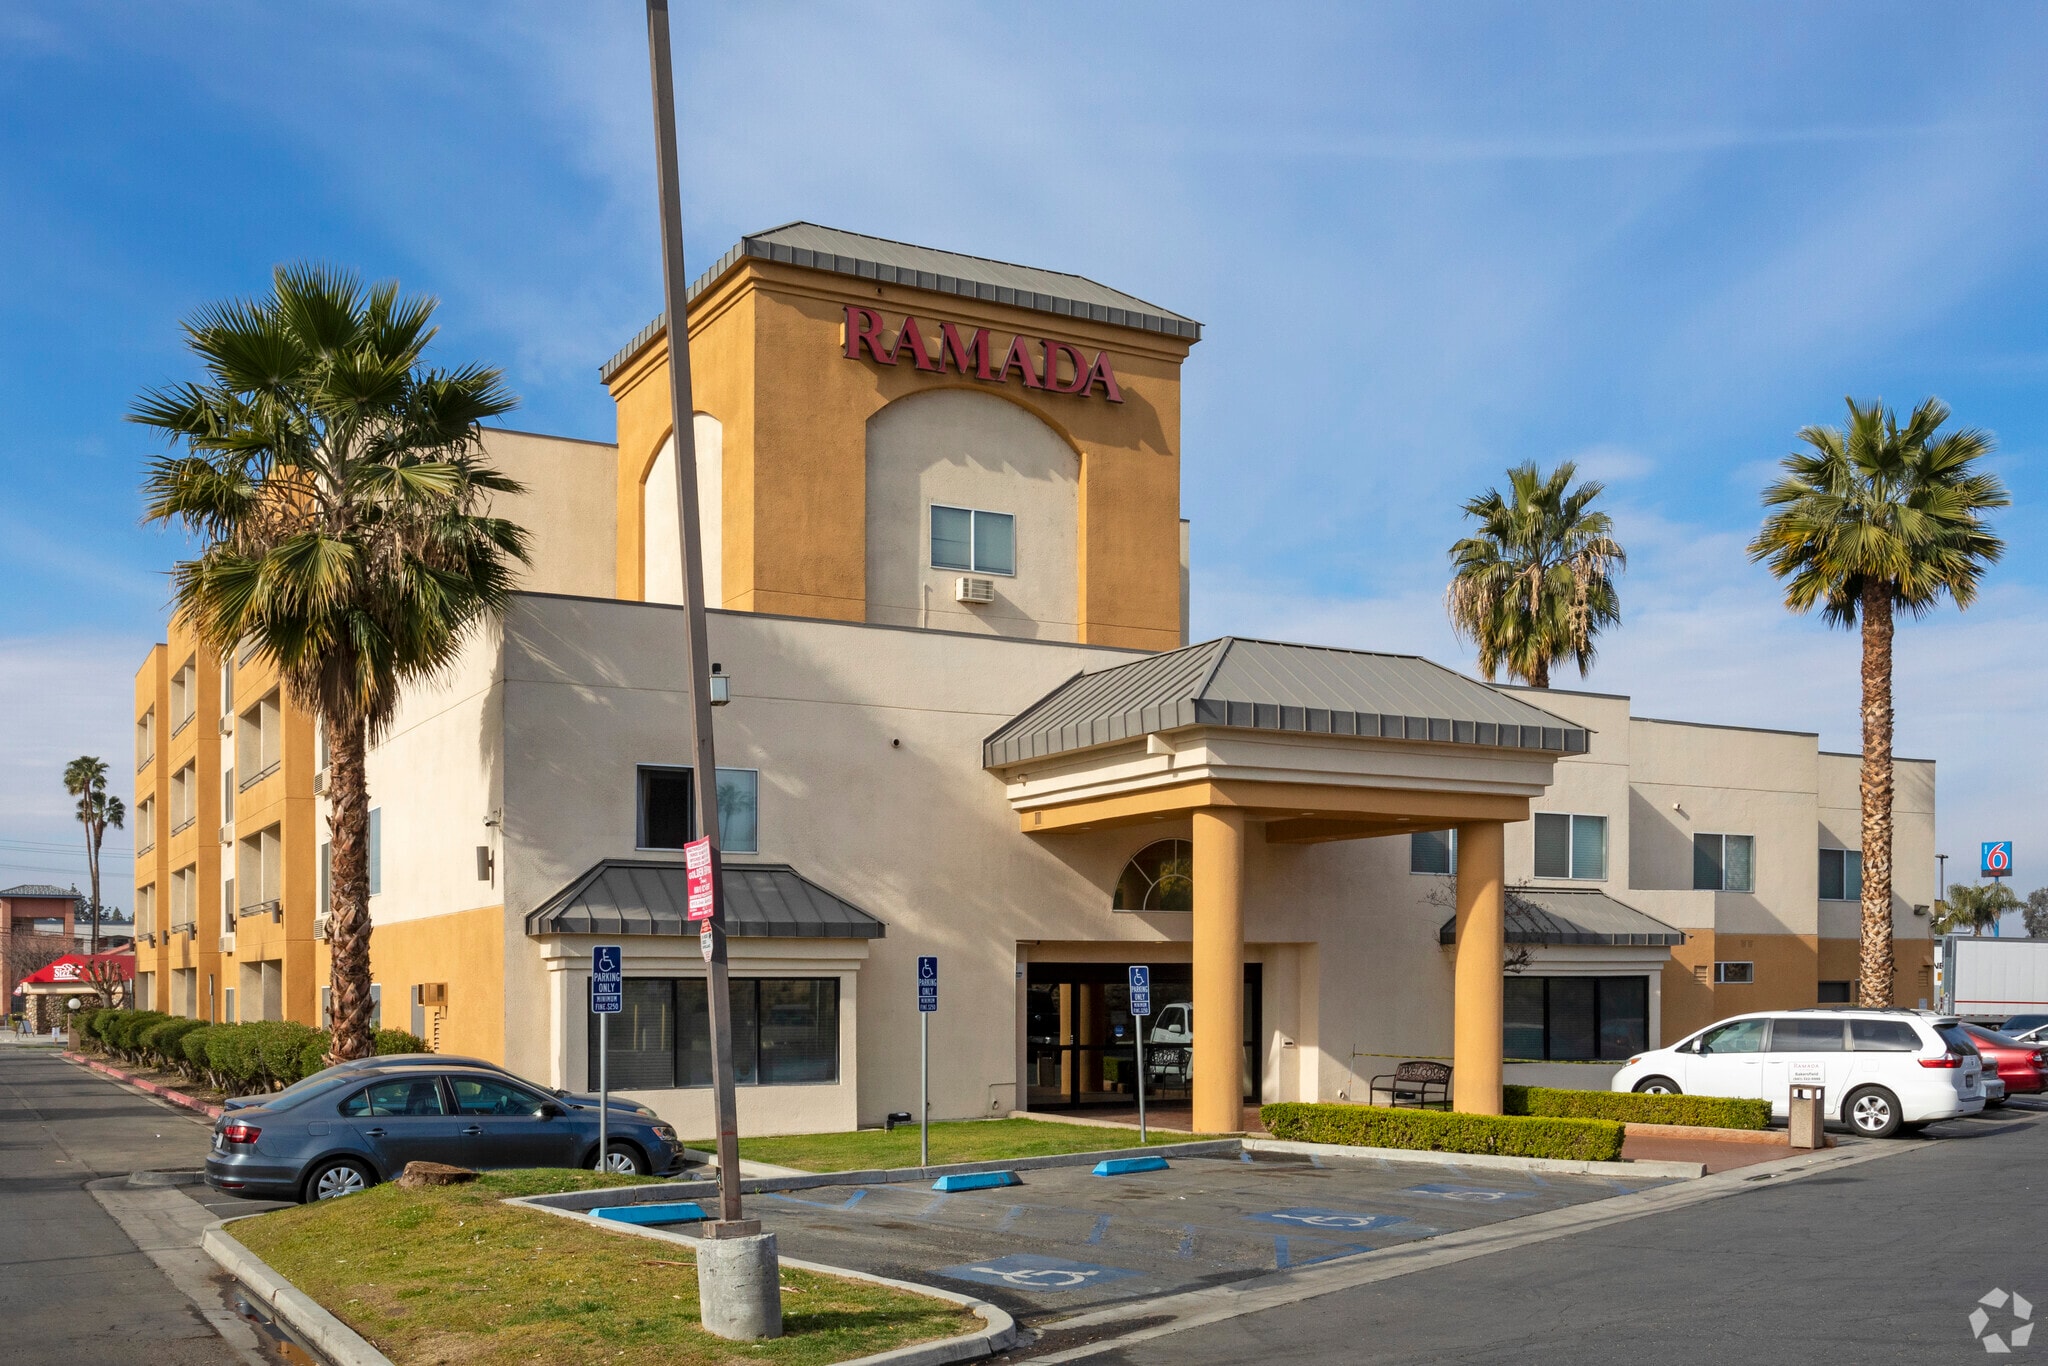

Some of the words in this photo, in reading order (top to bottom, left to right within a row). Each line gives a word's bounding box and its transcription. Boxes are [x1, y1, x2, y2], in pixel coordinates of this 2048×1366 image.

[843, 305, 1125, 403] RAMADA
[1987, 843, 2008, 870] 6
[594, 972, 620, 982] PARKING
[919, 978, 937, 986] PARKING
[598, 983, 615, 993] ONLY
[922, 987, 933, 996] ONLY
